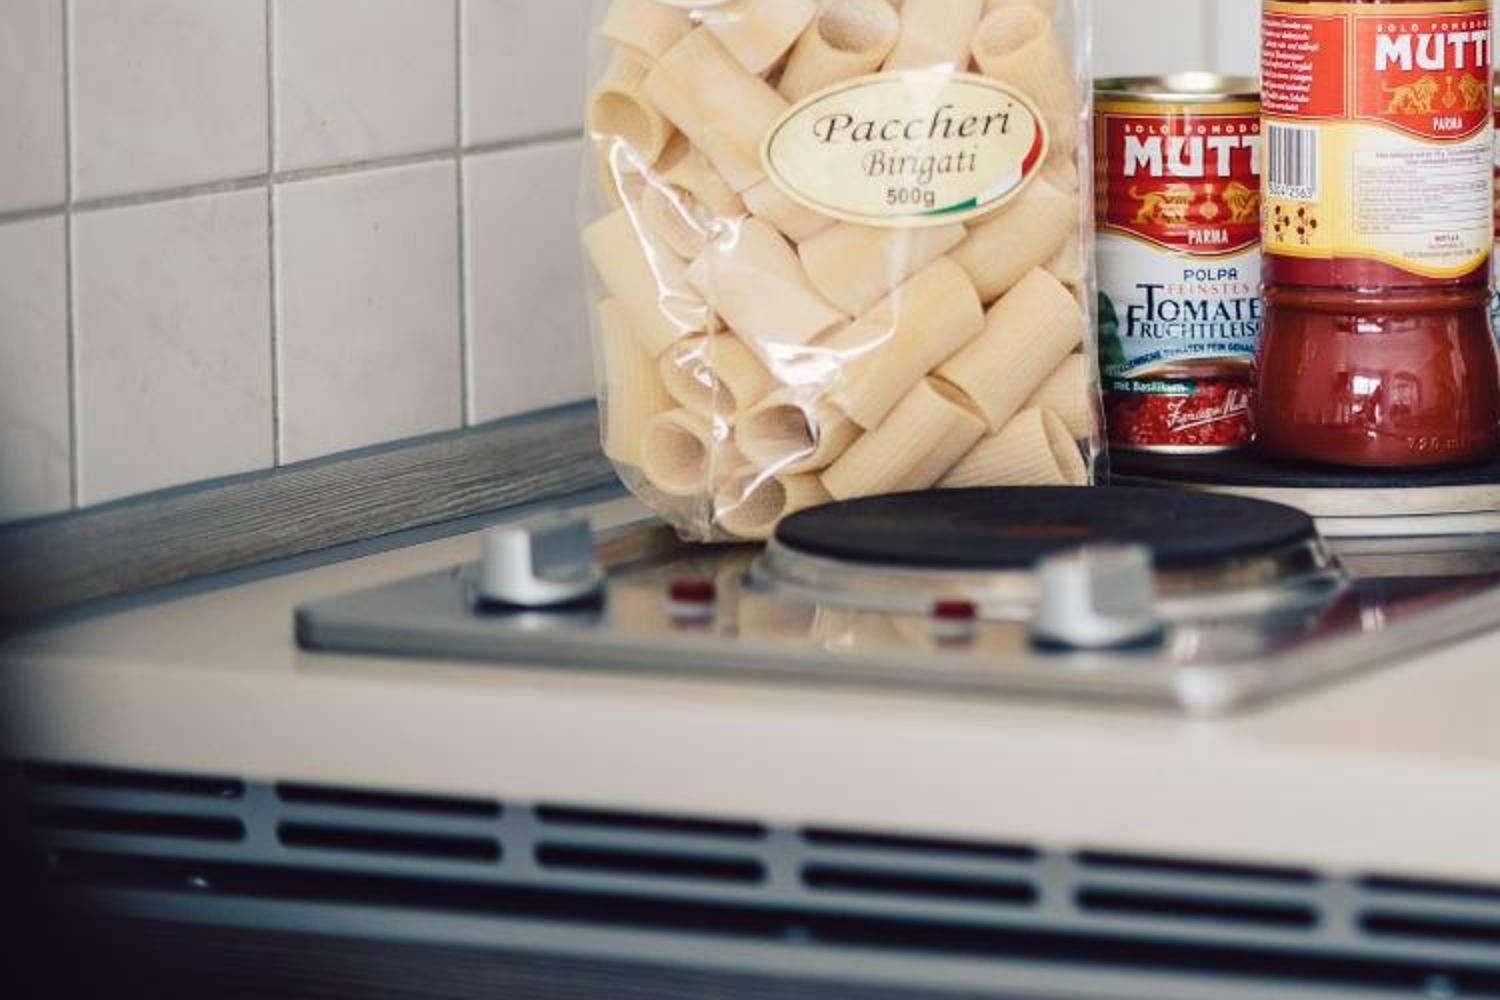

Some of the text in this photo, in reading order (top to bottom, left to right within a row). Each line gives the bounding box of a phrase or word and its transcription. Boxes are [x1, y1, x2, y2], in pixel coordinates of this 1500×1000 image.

[1377, 23, 1419, 33] SOLO
[812, 102, 1014, 144] Paccheri
[1124, 123, 1261, 135] SOLO POMODO
[1122, 135, 1261, 178] MUTT
[886, 187, 936, 208] 500g
[1187, 229, 1229, 245] PARMA
[1183, 267, 1240, 281] POLPA
[1136, 283, 1261, 322] TOMATE
[1126, 305, 1260, 339] FRUCHTFLEIS
